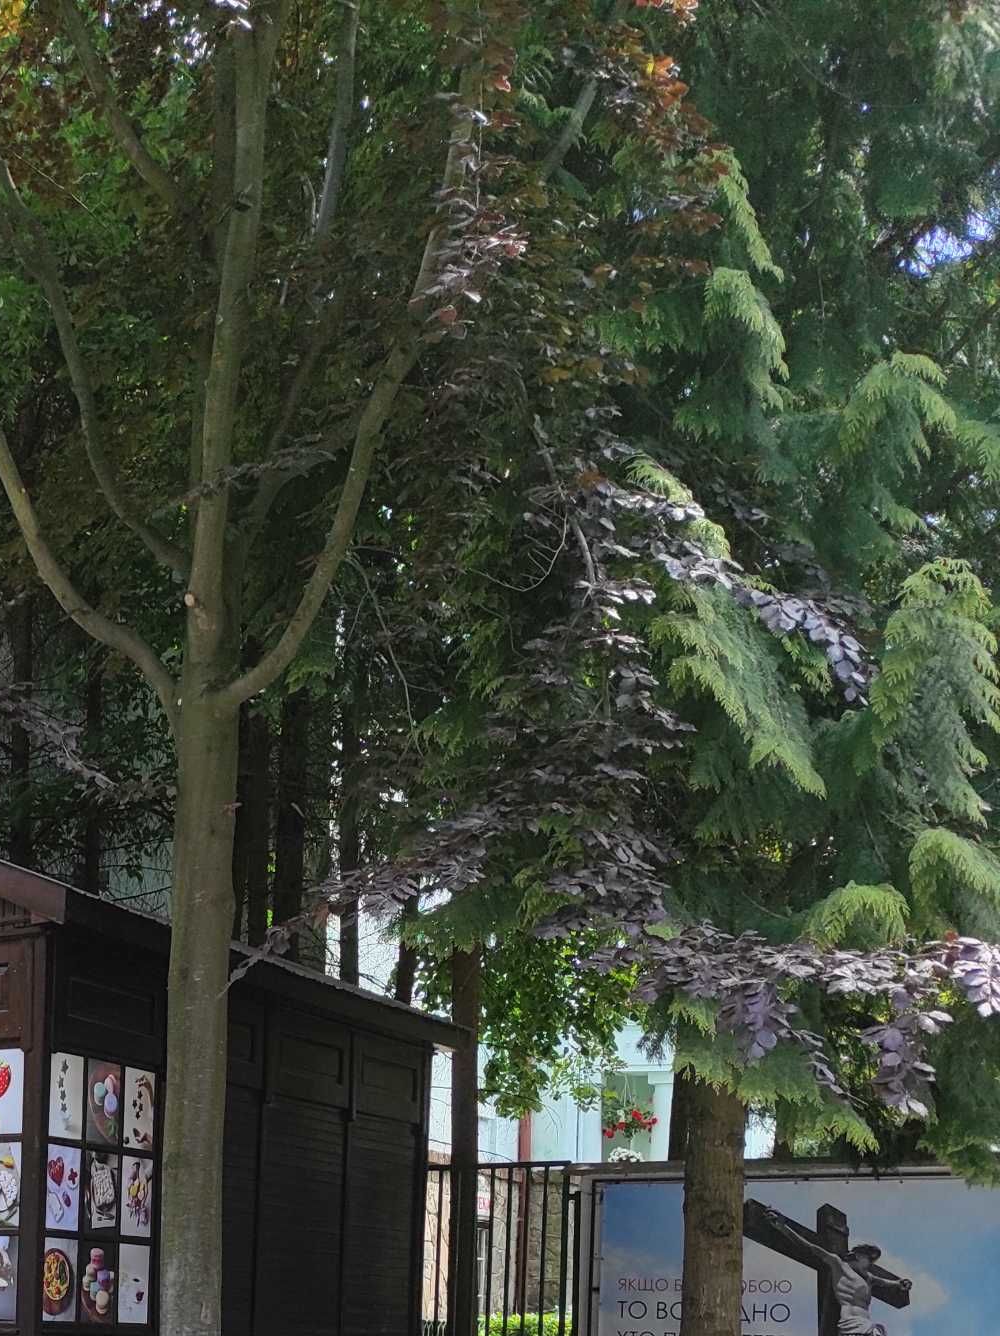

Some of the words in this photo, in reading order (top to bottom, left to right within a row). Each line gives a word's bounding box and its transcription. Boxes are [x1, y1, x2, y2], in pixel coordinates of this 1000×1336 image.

[617, 1278, 669, 1293] ЯКЩО
[616, 1300, 648, 1320] ТО
[740, 1303, 791, 1324] ДНО
